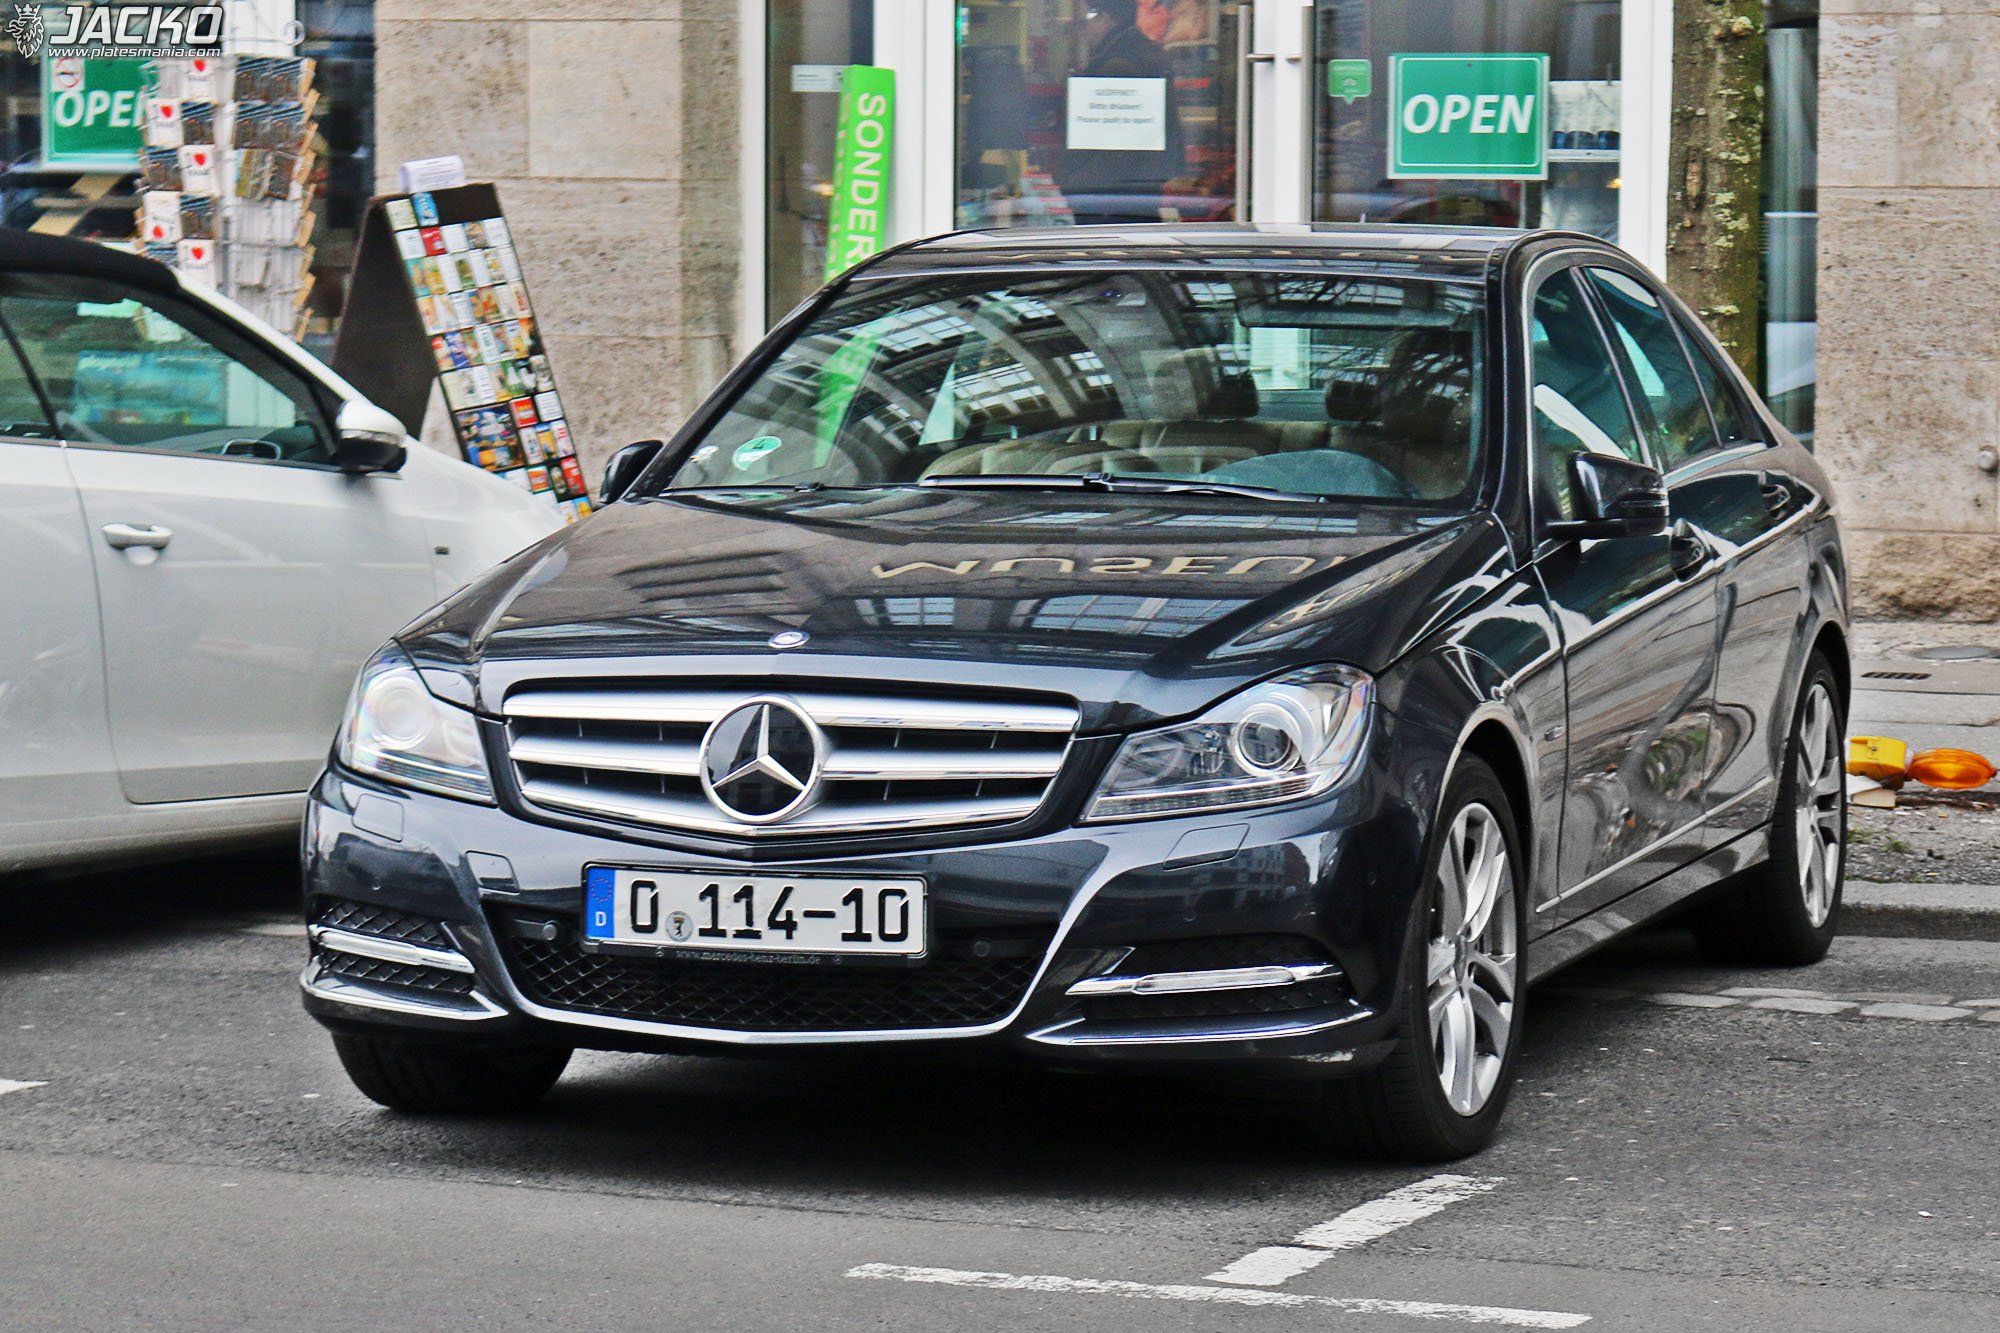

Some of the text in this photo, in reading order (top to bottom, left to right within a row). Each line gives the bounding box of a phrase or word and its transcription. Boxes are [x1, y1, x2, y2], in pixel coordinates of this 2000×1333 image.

[1403, 93, 1535, 134] OPEN
[845, 92, 887, 268] SONDER
[595, 911, 608, 927] D
